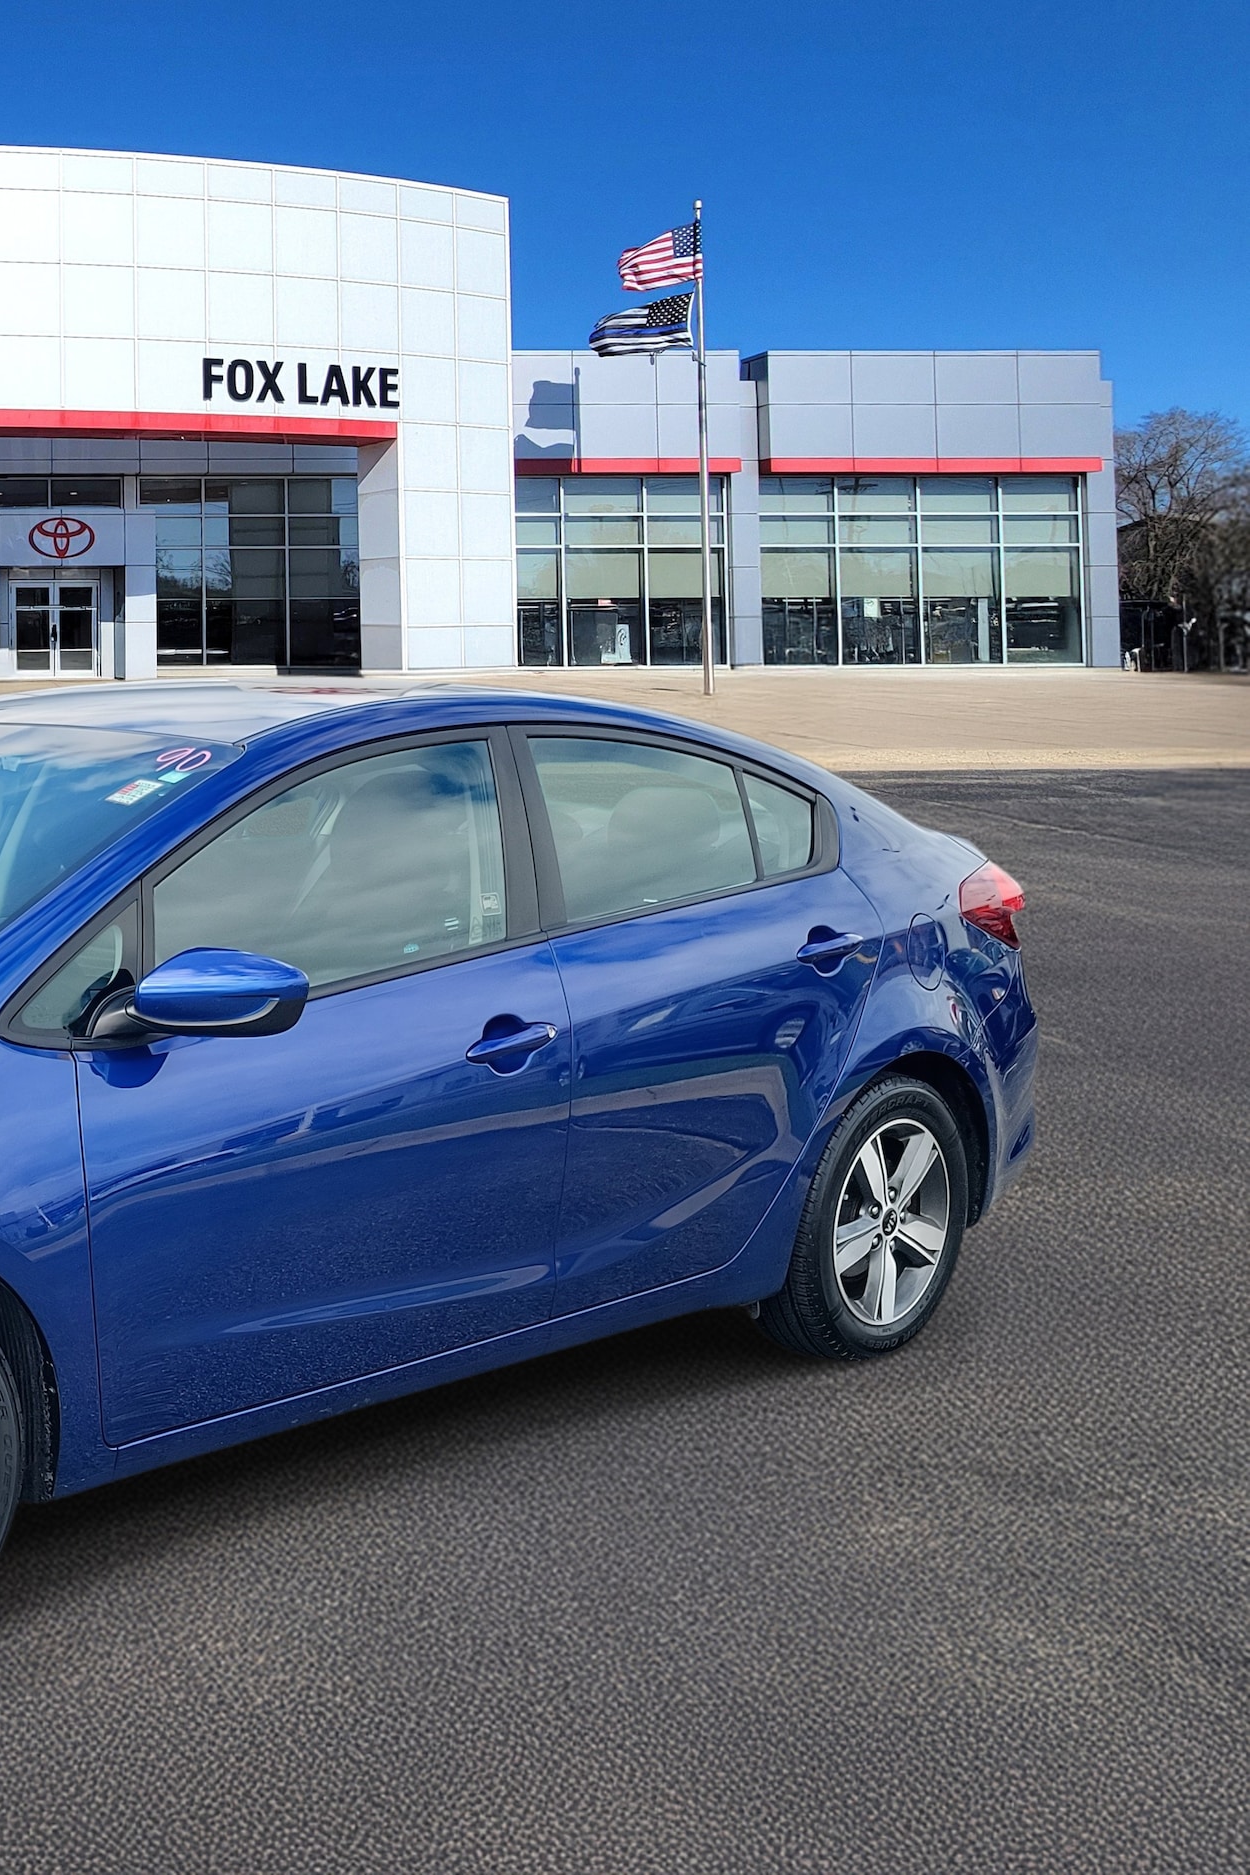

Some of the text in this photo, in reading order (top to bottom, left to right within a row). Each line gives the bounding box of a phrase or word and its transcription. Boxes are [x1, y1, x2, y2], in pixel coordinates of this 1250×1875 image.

[203, 358, 400, 408] FOX LAKE
[155, 747, 212, 772] 90
